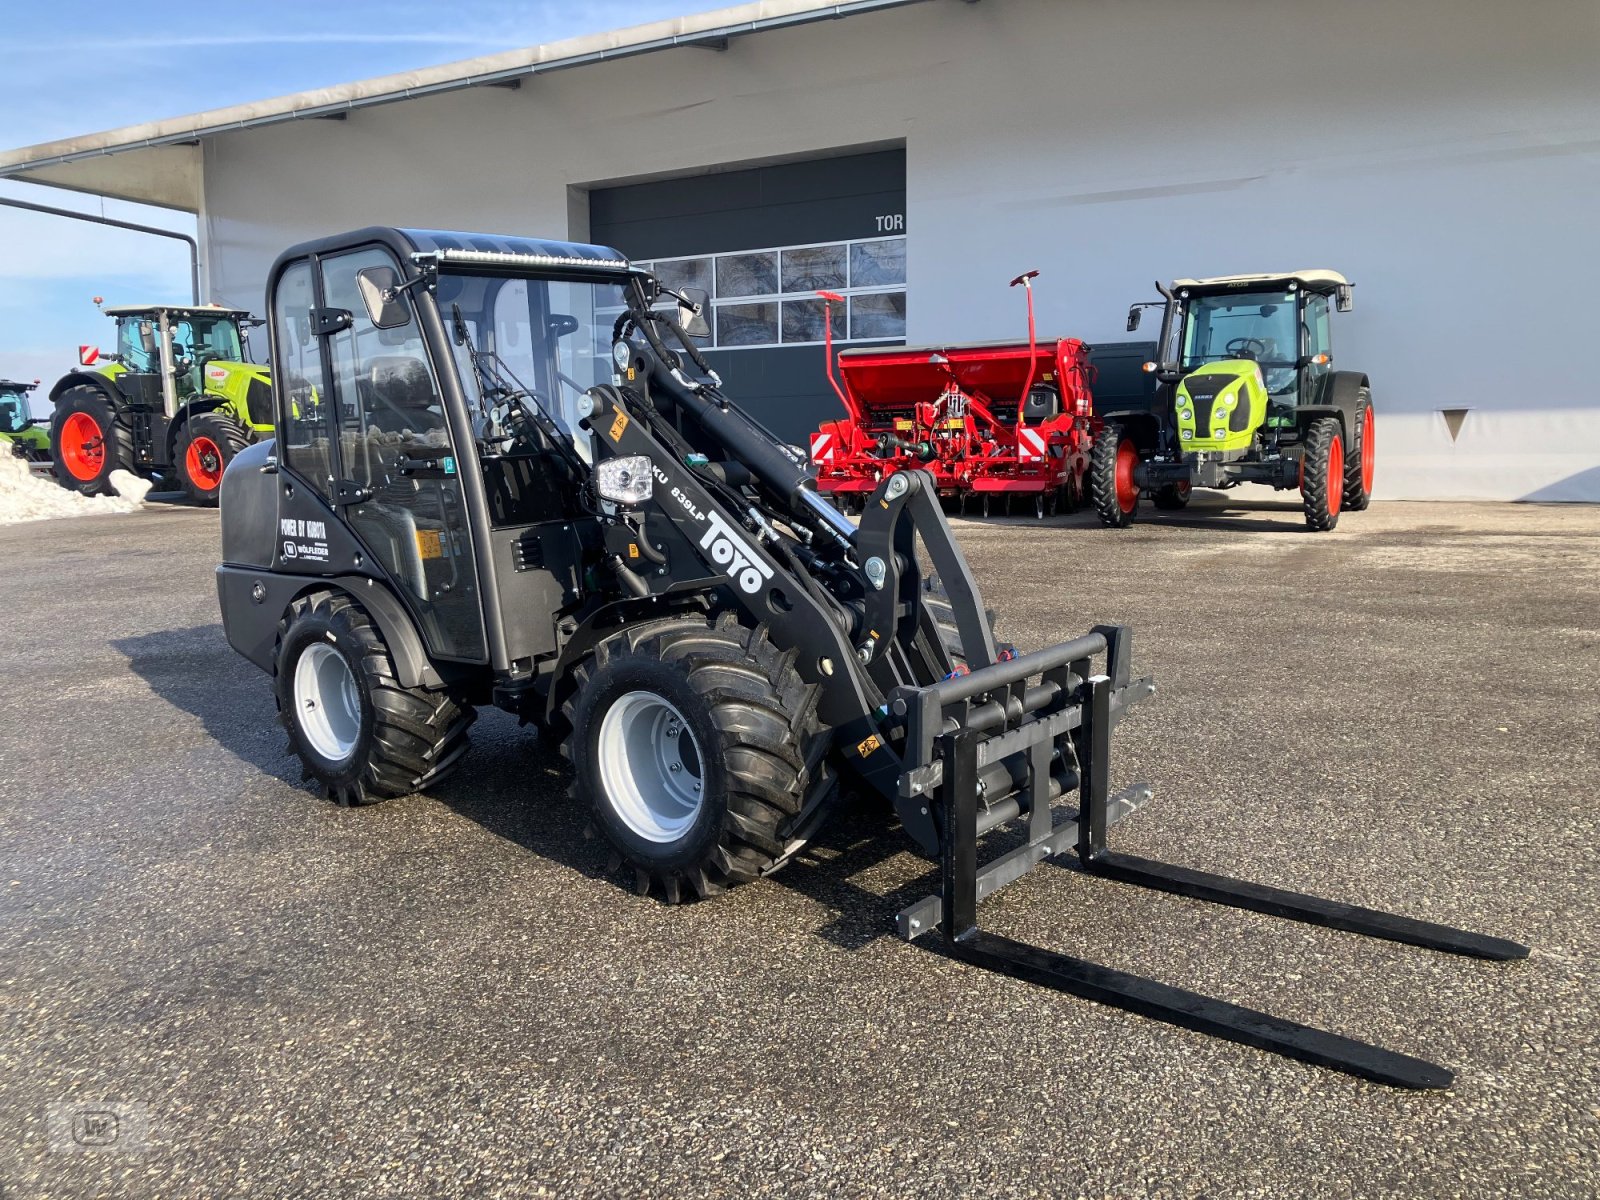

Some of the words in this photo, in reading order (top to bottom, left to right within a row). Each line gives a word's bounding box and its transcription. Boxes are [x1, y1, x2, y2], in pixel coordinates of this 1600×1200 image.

[875, 214, 903, 231] TOR
[652, 465, 669, 484] KU
[670, 487, 706, 521] 839LP
[280, 518, 297, 537] POWER
[298, 520, 305, 537] BY
[297, 544, 329, 556] WÖLFLEDER
[699, 509, 775, 594] TOYO
